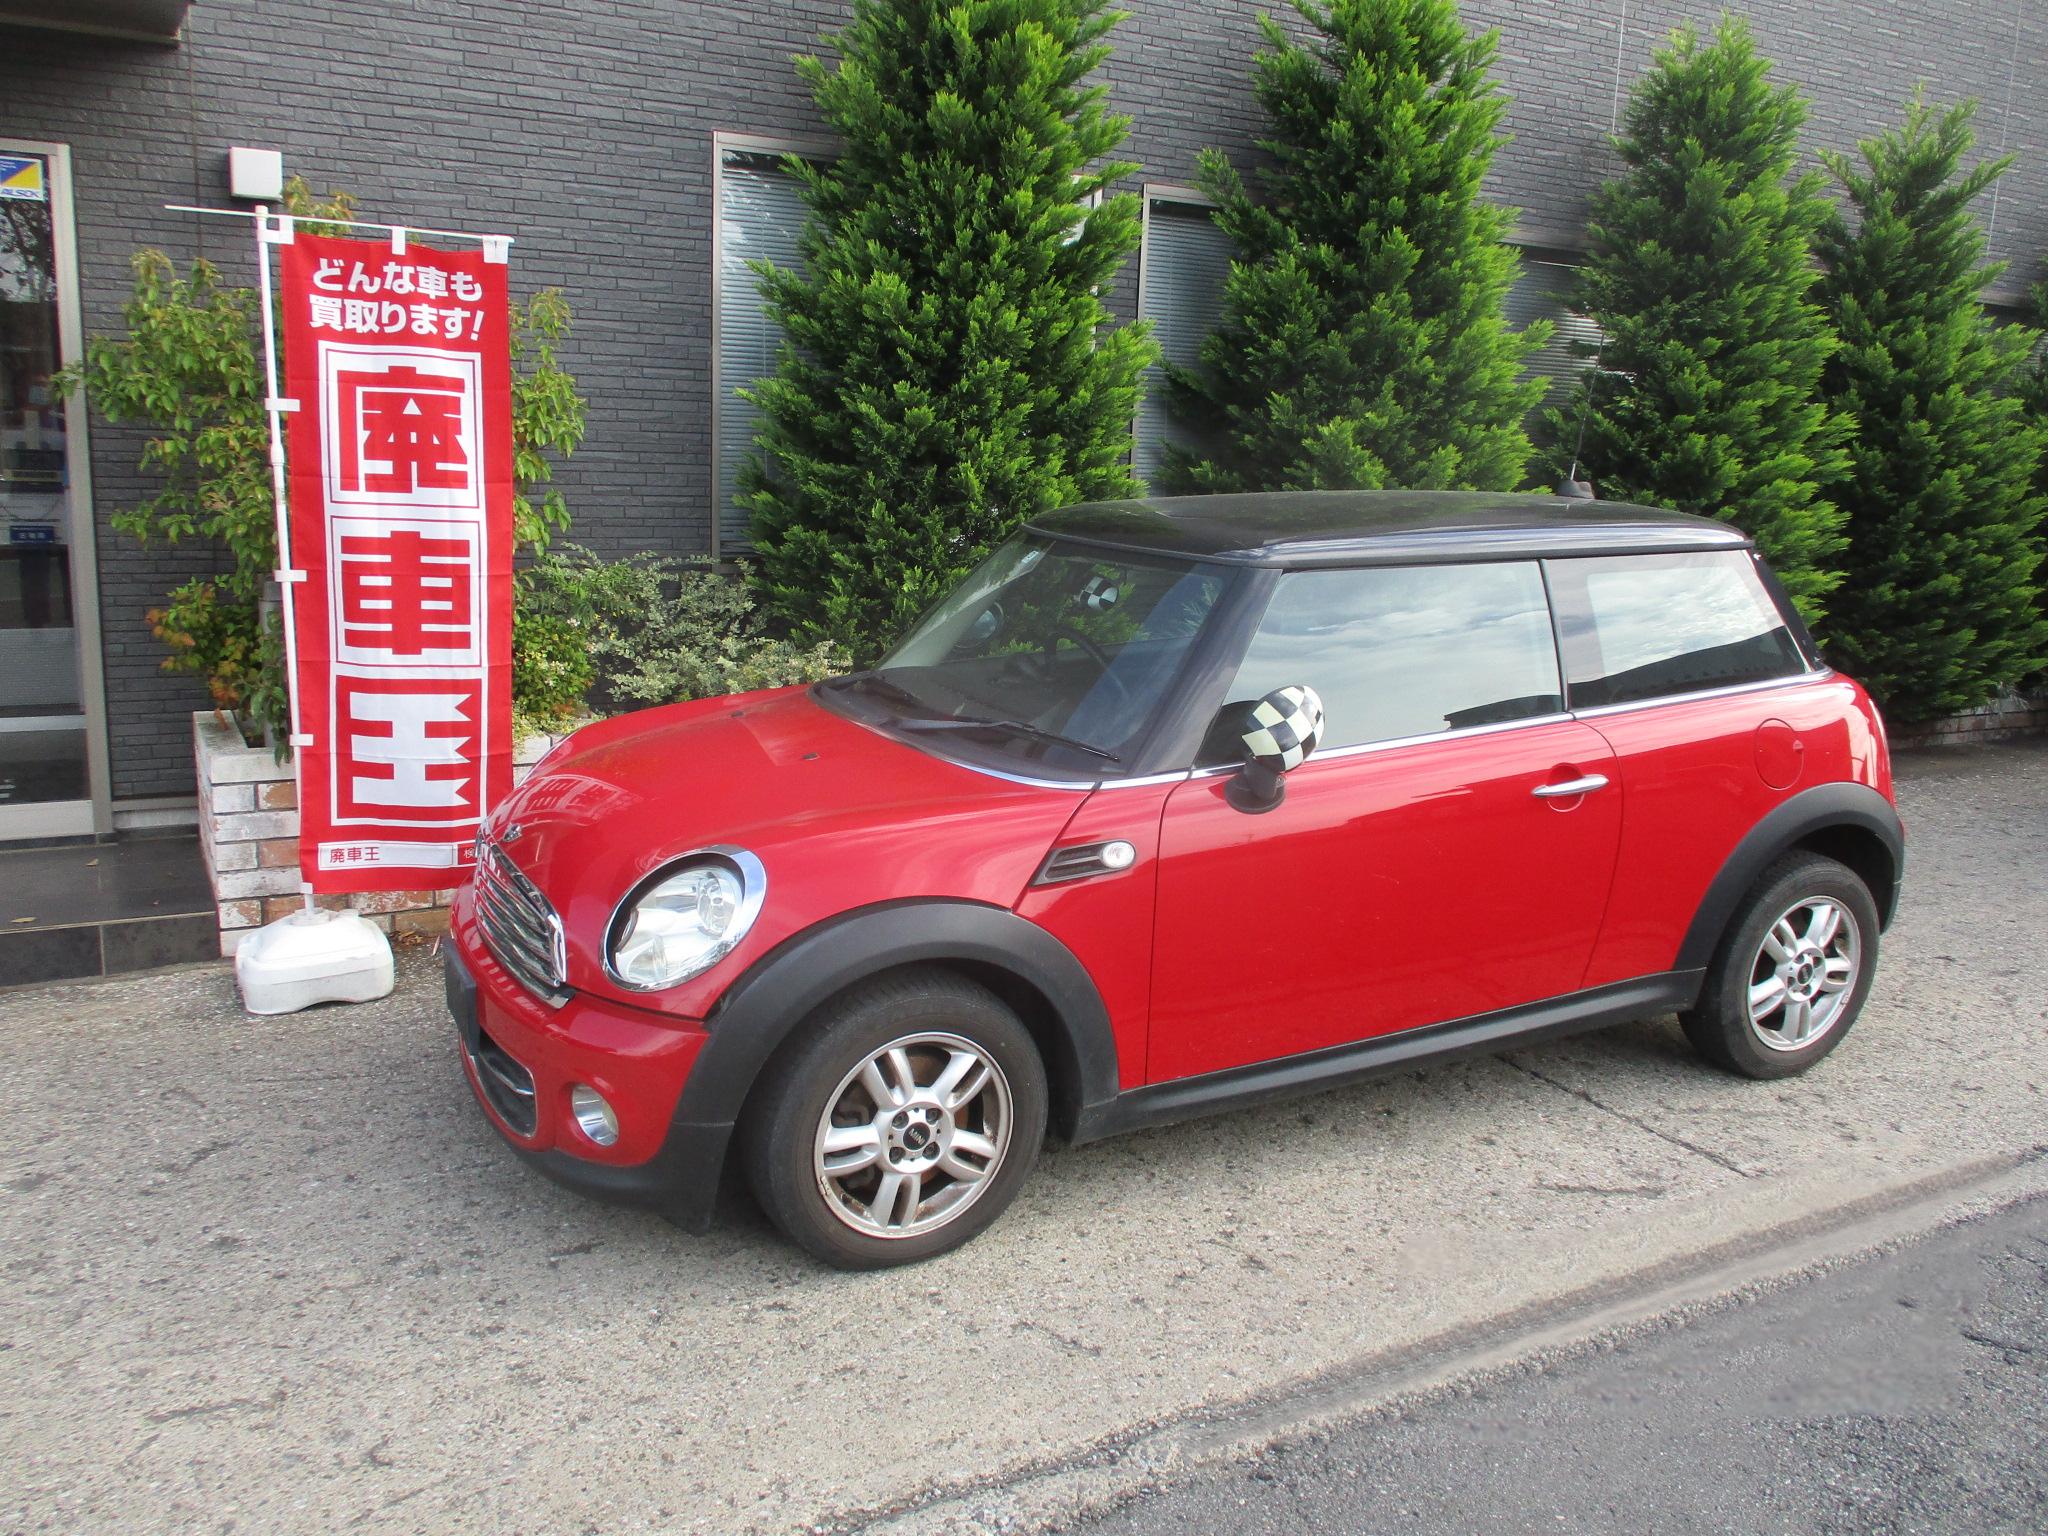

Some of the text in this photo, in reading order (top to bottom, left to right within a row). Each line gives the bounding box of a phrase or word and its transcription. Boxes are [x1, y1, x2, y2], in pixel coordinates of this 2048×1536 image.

[312, 257, 483, 302] どんな車も
[309, 294, 485, 341] 買取ります!
[336, 365, 472, 808] 廃車王
[329, 846, 380, 863] 廃車王
